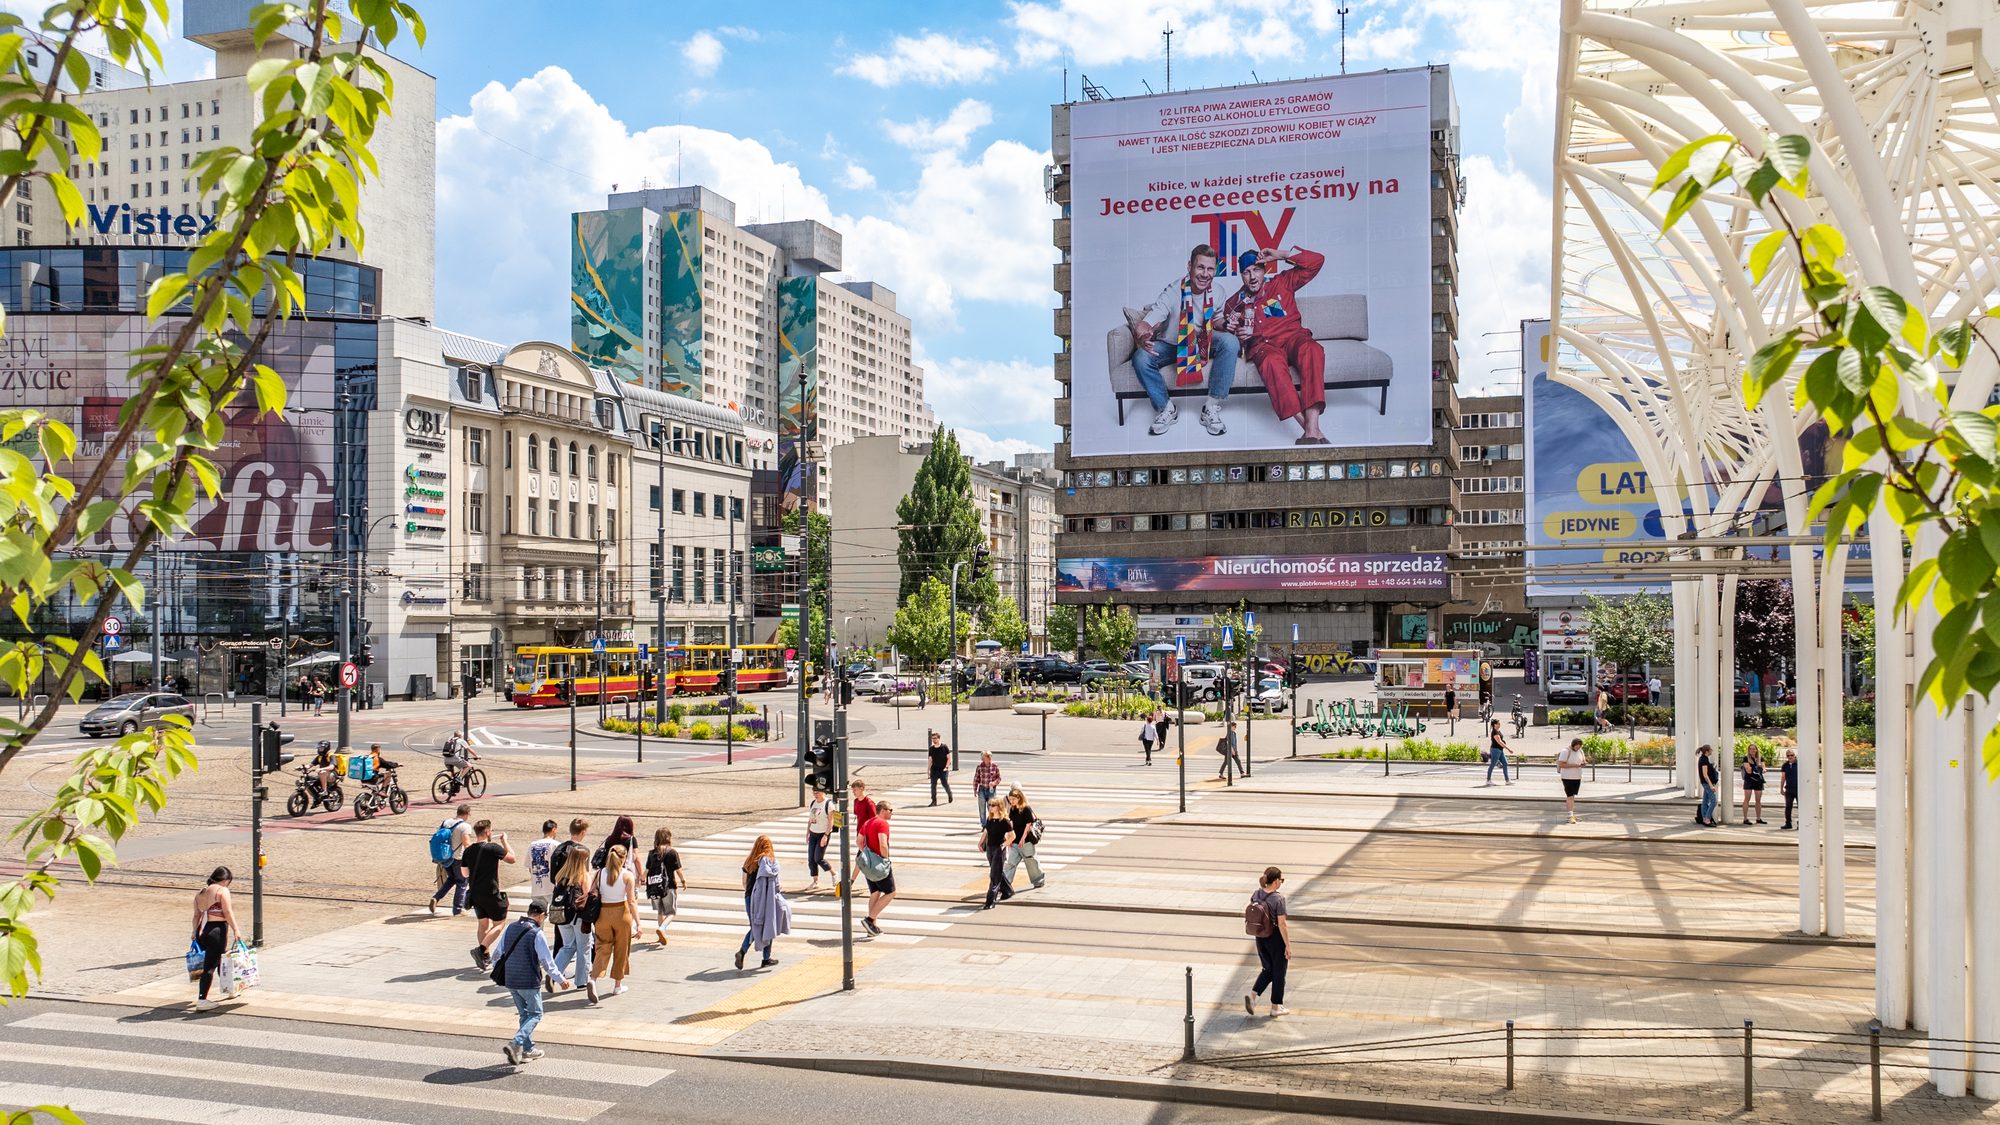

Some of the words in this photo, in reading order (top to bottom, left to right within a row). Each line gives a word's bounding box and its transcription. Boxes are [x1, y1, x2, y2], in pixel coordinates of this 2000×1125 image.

[1159, 107, 1172, 116] 1/2
[1174, 105, 1201, 115] LITRA
[1203, 103, 1227, 112] PIWA
[1229, 98, 1272, 110] ZAWIERA
[1274, 97, 1285, 105] 25
[1287, 92, 1333, 104] GRAMÓW
[1161, 115, 1211, 126] CZYSTEGO
[1213, 109, 1266, 121] ALKOHOLU
[1269, 103, 1331, 116] ETYLOWEGO
[1118, 137, 1150, 147] NAWET
[1153, 135, 1177, 144] TAKA
[1179, 130, 1206, 141] ILOŚĆ
[1209, 128, 1249, 139] SZKODZI
[1251, 124, 1296, 135] ZDROWIU
[1298, 120, 1334, 131] KOBIET
[1336, 119, 1345, 127] W
[1347, 115, 1377, 127] CIĄŻY
[1156, 145, 1179, 154] JEST
[1181, 138, 1255, 152] NIEBEZPIECZNA
[1257, 136, 1277, 145] DLA
[1279, 129, 1341, 143] KIEROWCÓW
[1148, 180, 1187, 193] Kibice,
[1191, 181, 1200, 189] w
[1204, 175, 1242, 187] każdej
[1246, 171, 1286, 184] strefie
[1289, 166, 1345, 181] czasowej
[1369, 178, 1399, 195] na
[87, 203, 218, 236] Vistex
[2, 362, 72, 398] życie
[406, 408, 446, 436] CBL
[1600, 471, 1648, 495] LAT
[1560, 517, 1620, 535] JEDYNE
[1214, 557, 1336, 575] Nieruchomość
[1339, 560, 1360, 573] na
[1364, 556, 1443, 576] sprzedaż
[1619, 551, 1665, 563] RODZ
[1367, 578, 1380, 586] tel.
[1381, 578, 1395, 586] +48
[105, 621, 119, 631] 30
